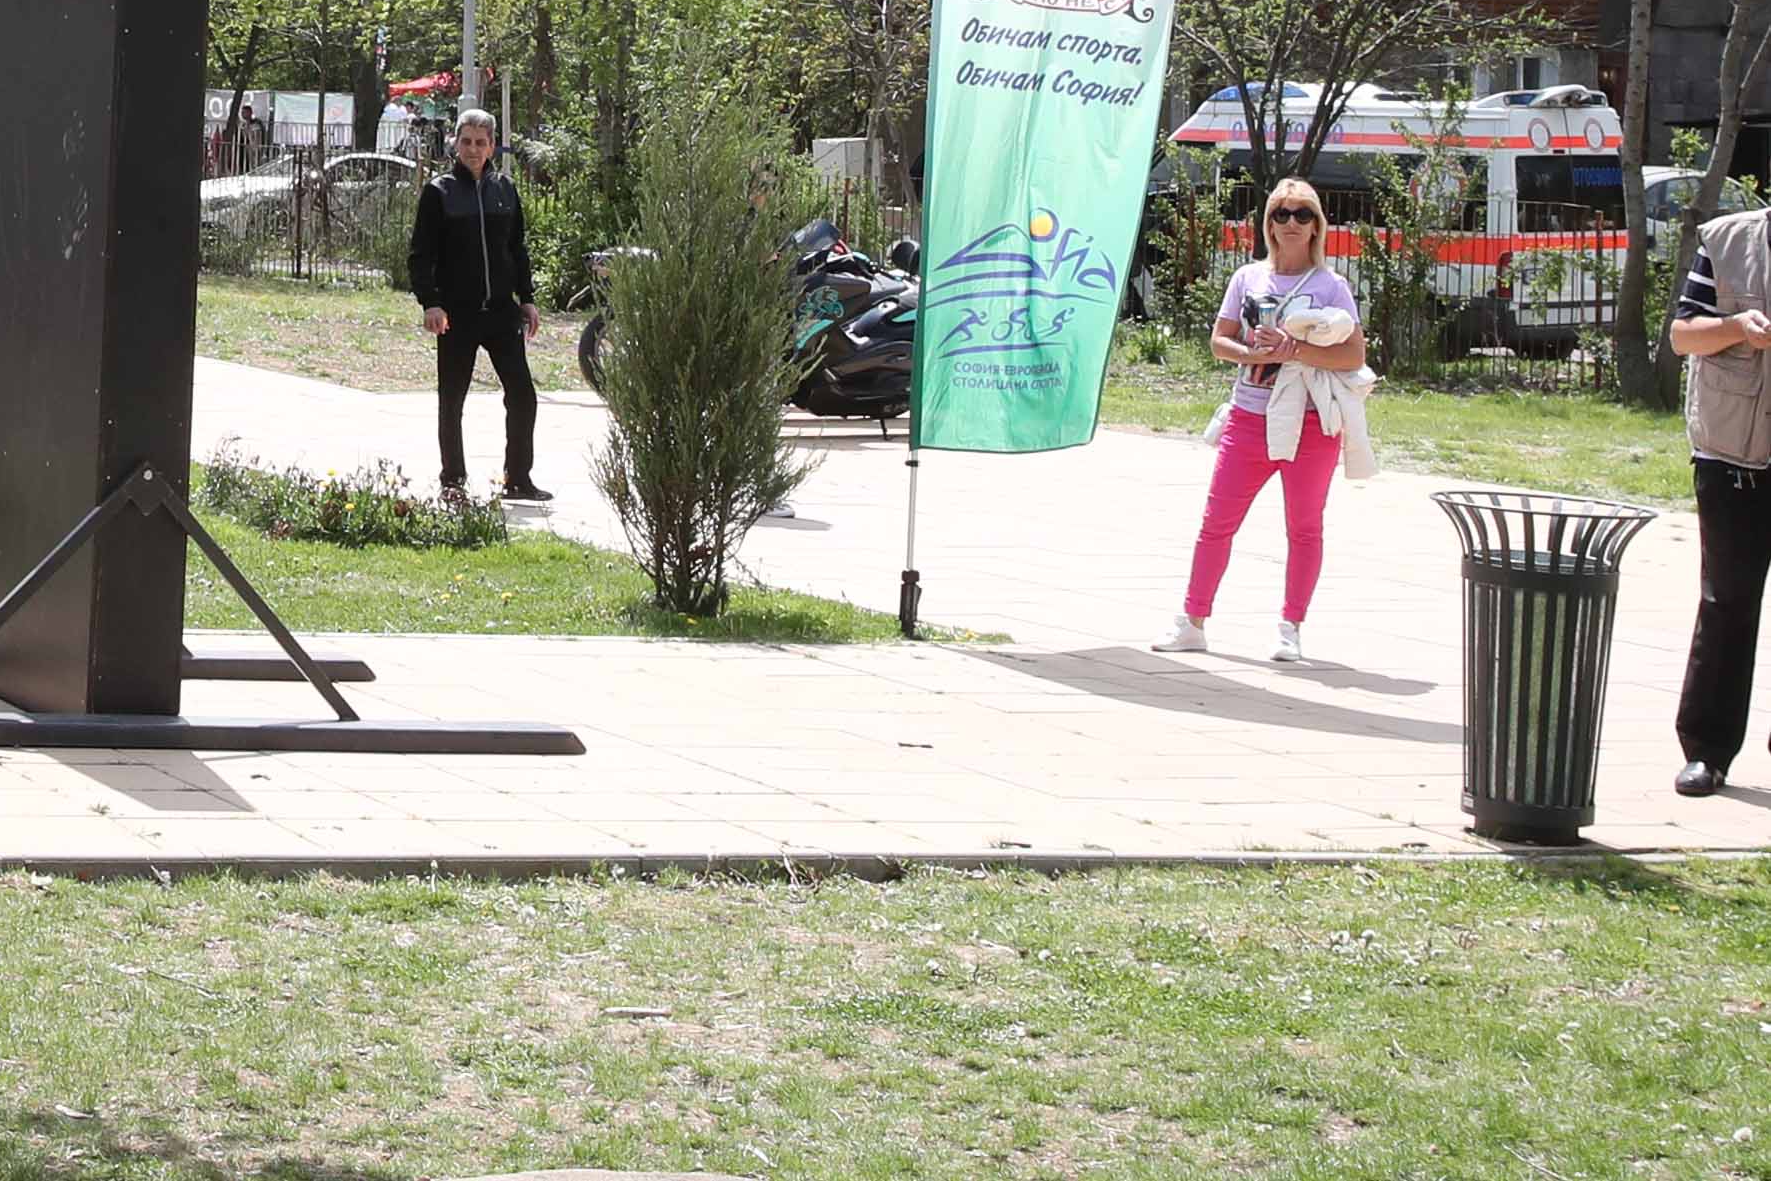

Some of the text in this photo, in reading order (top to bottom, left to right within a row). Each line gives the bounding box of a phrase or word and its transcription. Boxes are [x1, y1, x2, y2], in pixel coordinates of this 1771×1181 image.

[961, 17, 1051, 50] Обичам
[956, 60, 1145, 107] Обичам София!
